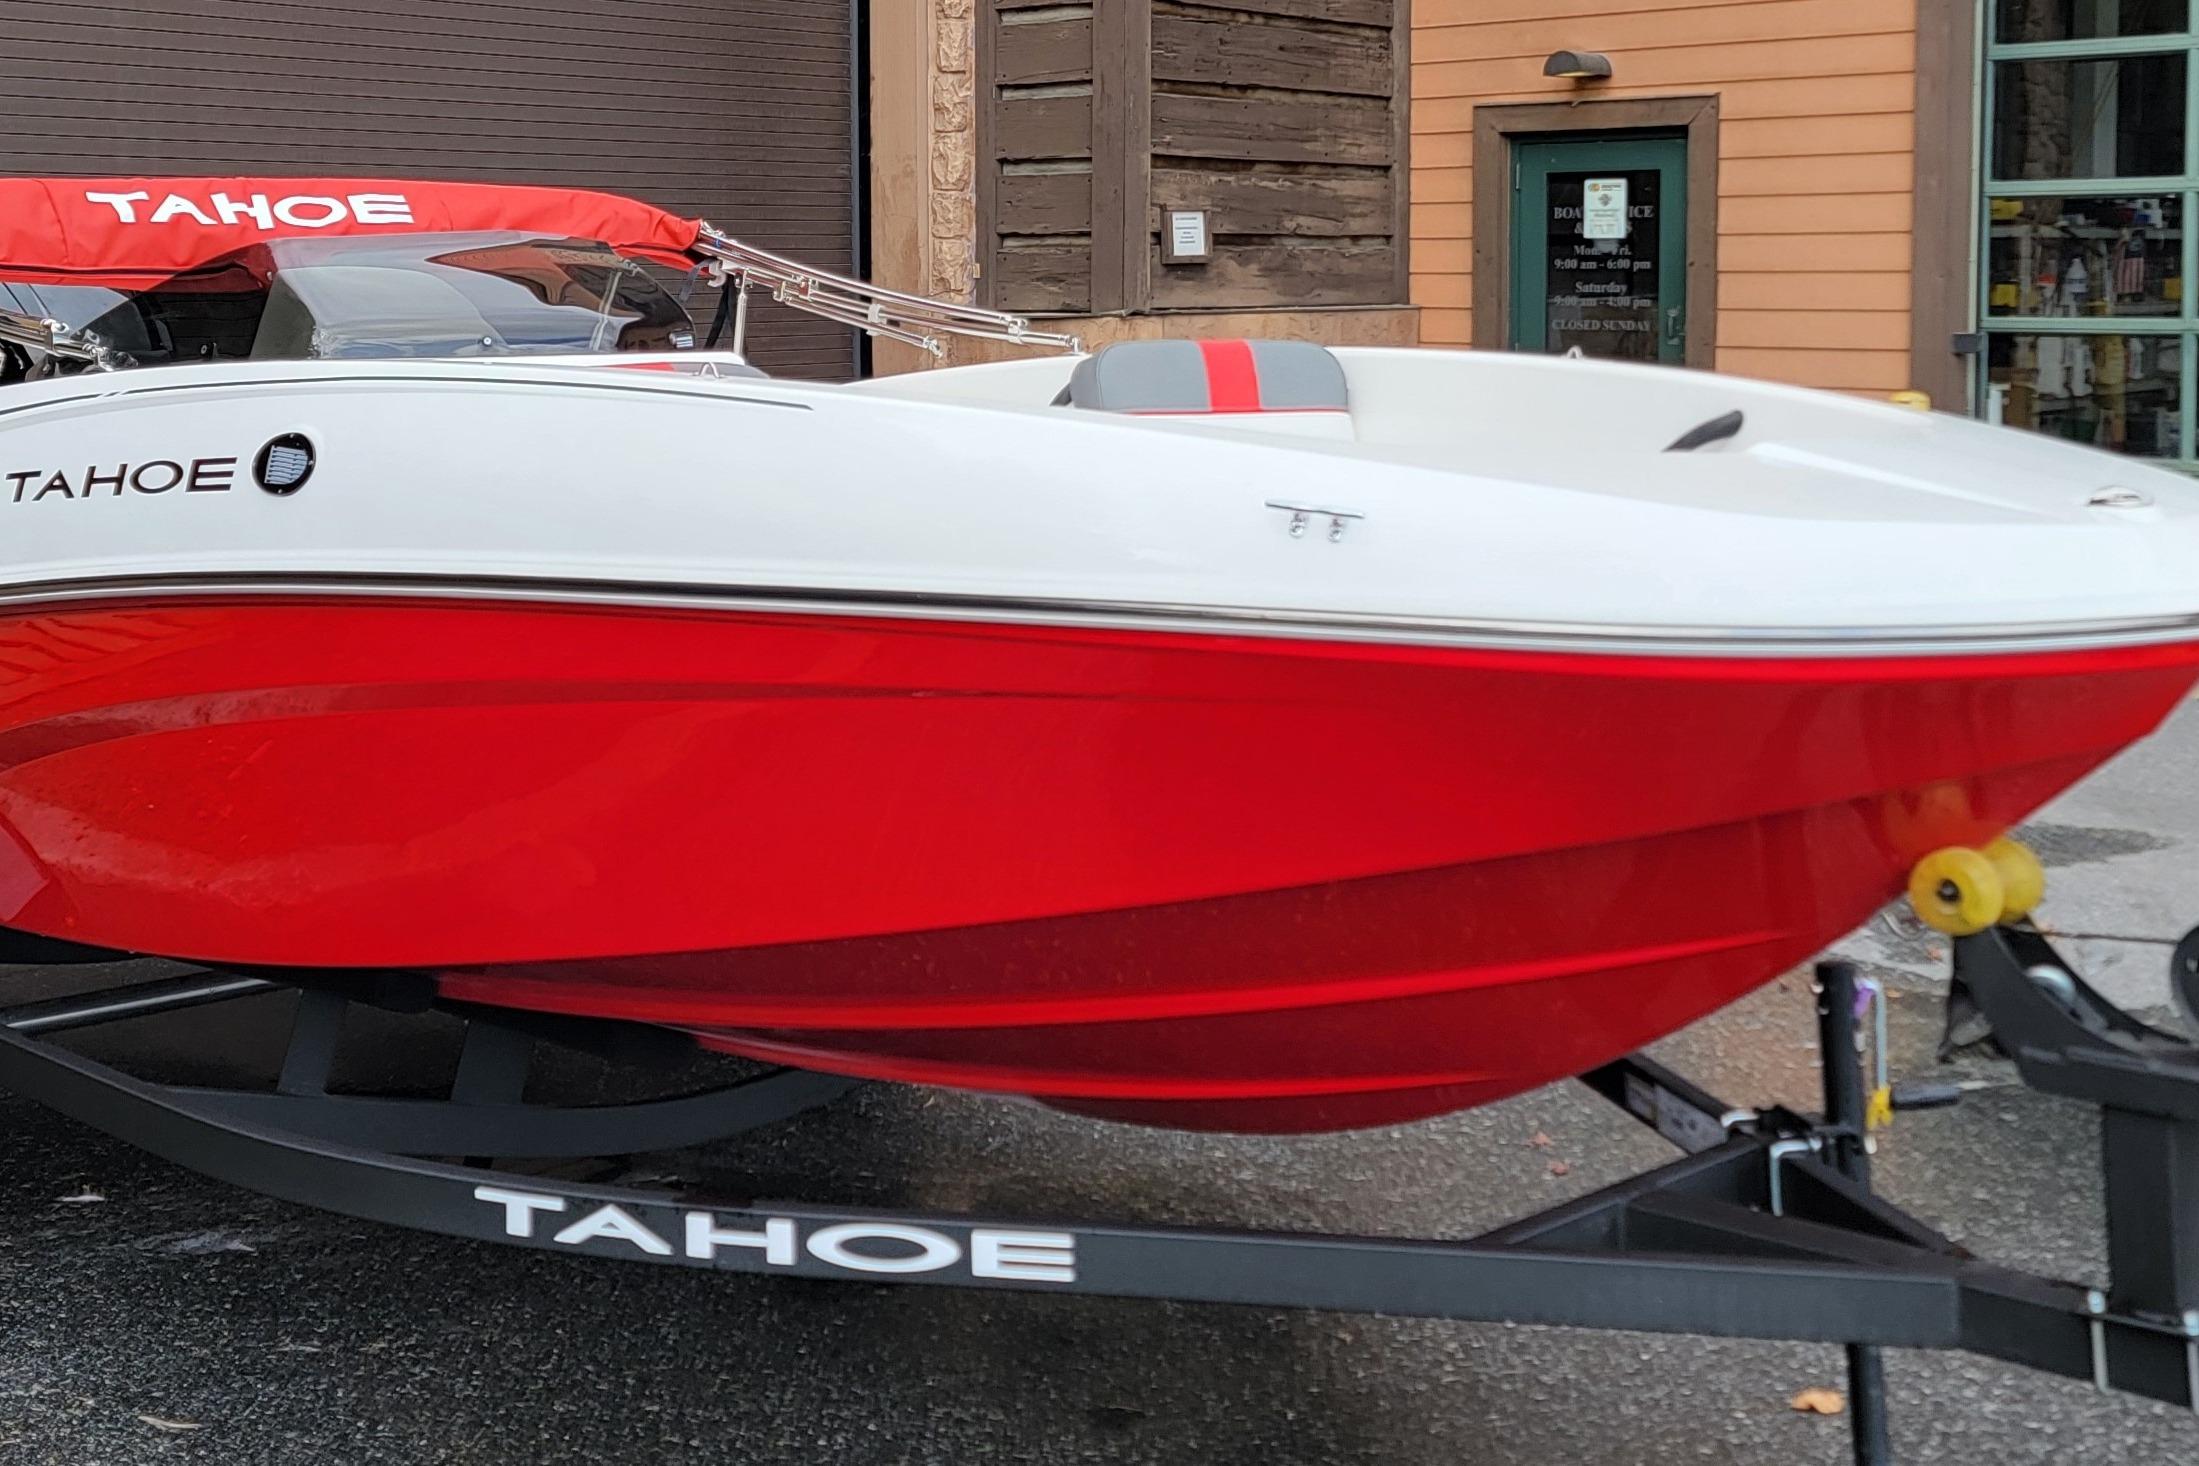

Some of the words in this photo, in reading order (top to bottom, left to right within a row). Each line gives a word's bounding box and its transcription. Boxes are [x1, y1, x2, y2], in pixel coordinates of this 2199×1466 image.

[86, 191, 414, 229] TAHOE
[1553, 207, 1584, 219] BOA
[1554, 259, 1578, 269] 9:00
[1579, 261, 1597, 269] am
[1606, 258, 1631, 269] 6:00
[1633, 261, 1652, 272] pm
[1575, 281, 1628, 295] Saturday
[1552, 320, 1600, 330] CLOSED
[1602, 320, 1650, 331] SUNDAY
[5, 457, 238, 503] TAHOE
[474, 1186, 1076, 1282] TAHOE
